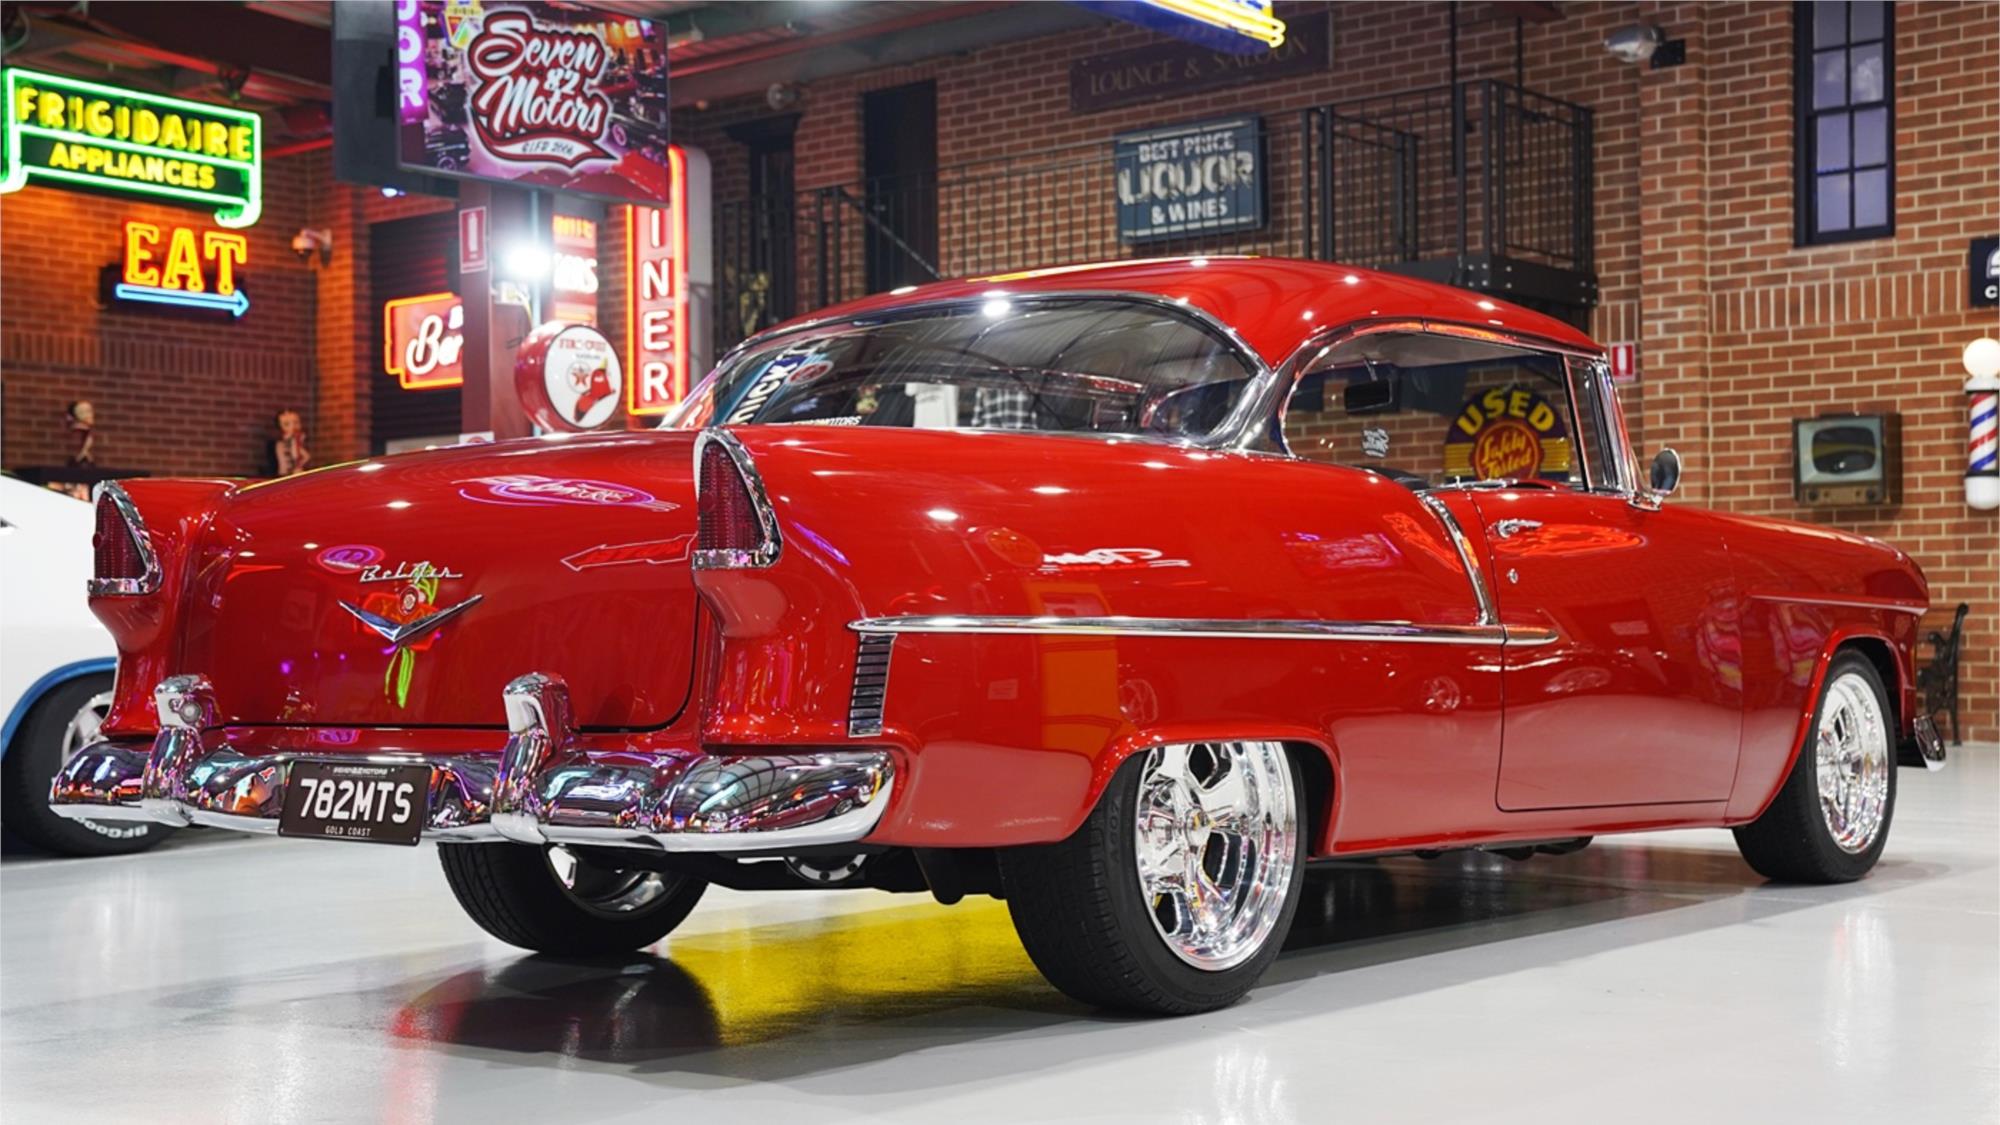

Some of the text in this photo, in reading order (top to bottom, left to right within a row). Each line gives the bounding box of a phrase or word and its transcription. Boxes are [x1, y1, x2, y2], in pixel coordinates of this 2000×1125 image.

[476, 20, 599, 76] Seven
[543, 68, 580, 95] 82
[1090, 60, 1173, 96] LOUNGE
[1184, 59, 1200, 79] &
[16, 86, 252, 160] FRIGIDAIRE
[478, 76, 603, 133] Motors
[49, 143, 216, 189] APPLIANCES
[1138, 131, 1234, 163] BEST PRICE
[1117, 151, 1254, 206] LIQUOR
[1151, 197, 1228, 226] & WINES
[125, 221, 247, 295] EAT
[643, 209, 671, 401] INER
[1457, 389, 1555, 435] USED
[300, 778, 414, 824] 782MTS
[325, 825, 371, 837] GOLD COAST
